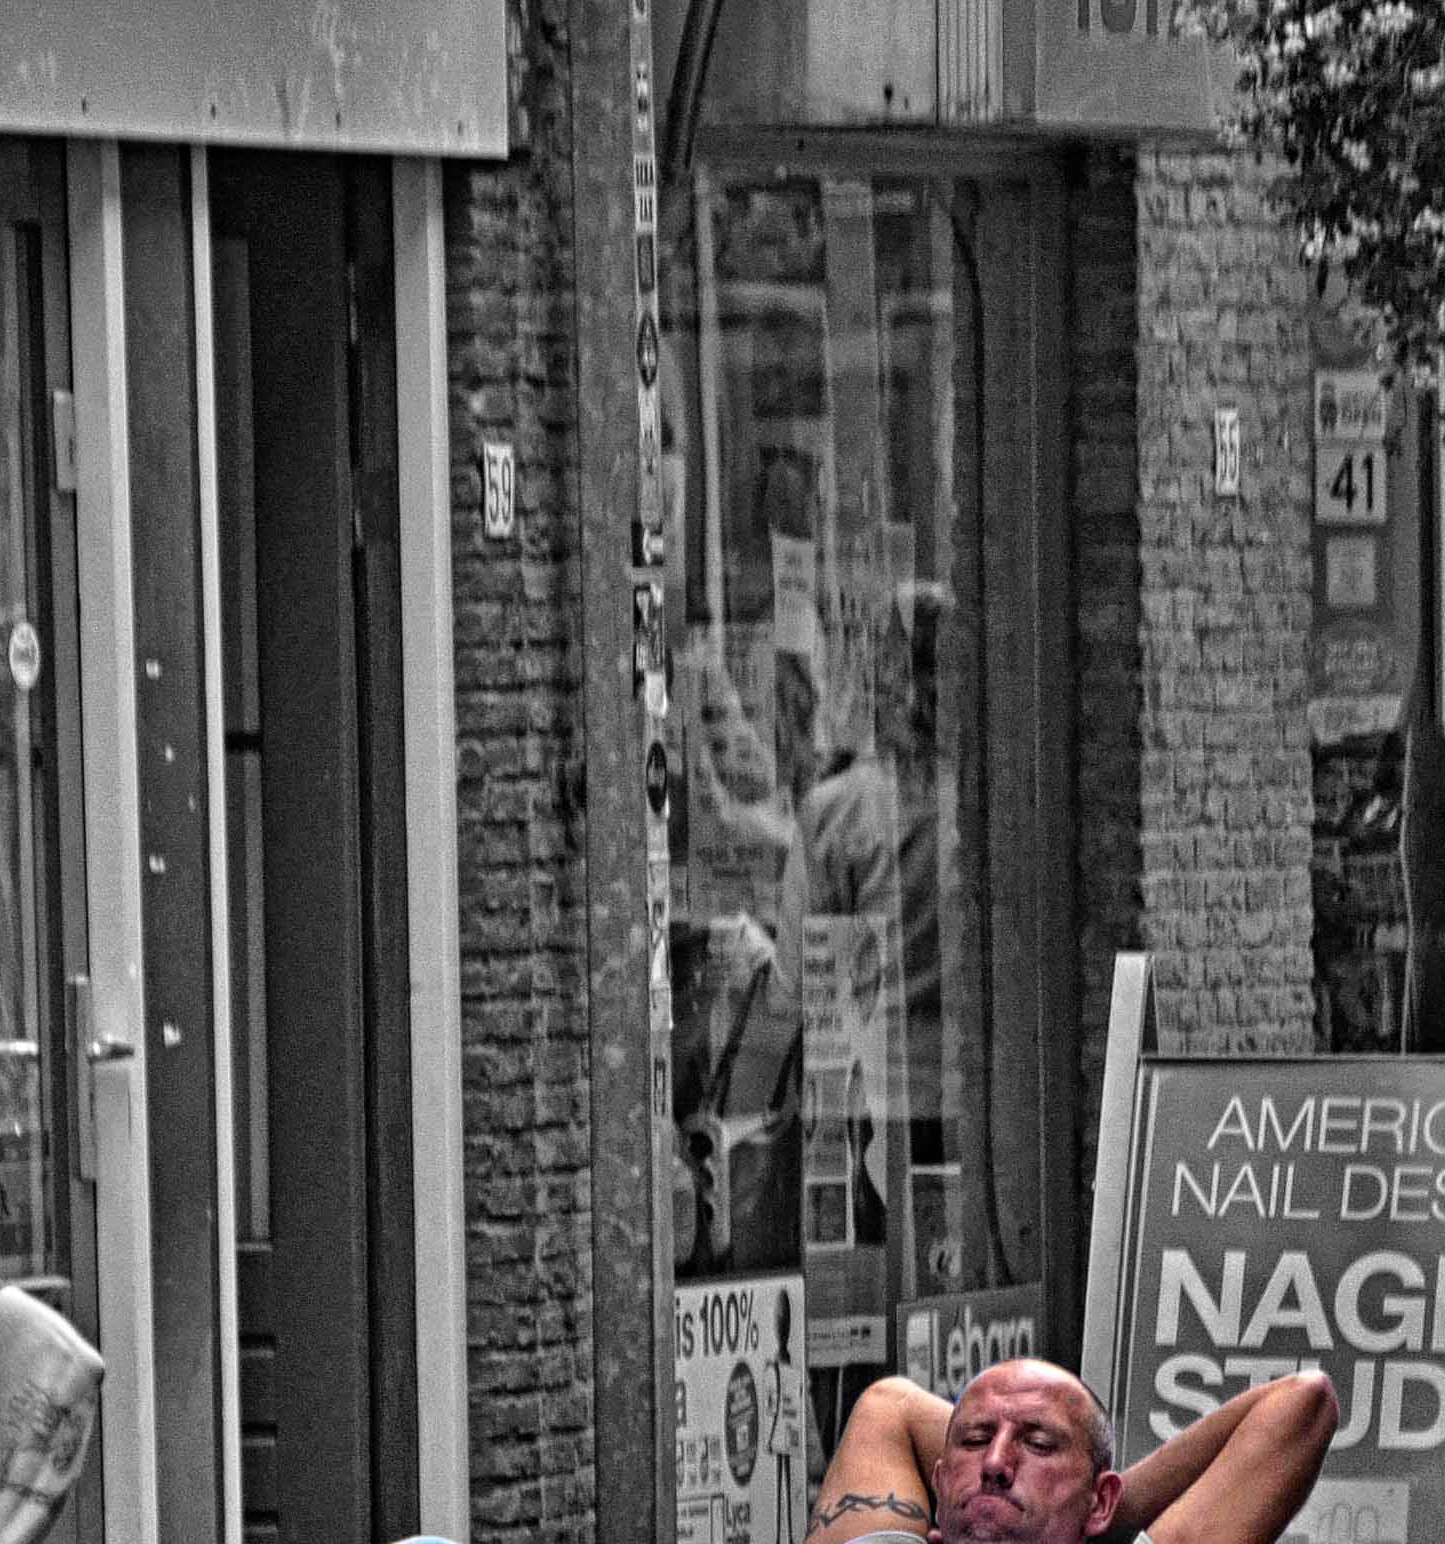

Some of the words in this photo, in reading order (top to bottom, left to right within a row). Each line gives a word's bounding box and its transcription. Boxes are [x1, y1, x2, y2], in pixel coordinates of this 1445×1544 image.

[486, 450, 511, 523] 59
[1329, 453, 1374, 513] 41
[1172, 1163, 1319, 1219] NAIL
[700, 1289, 759, 1357] 100%
